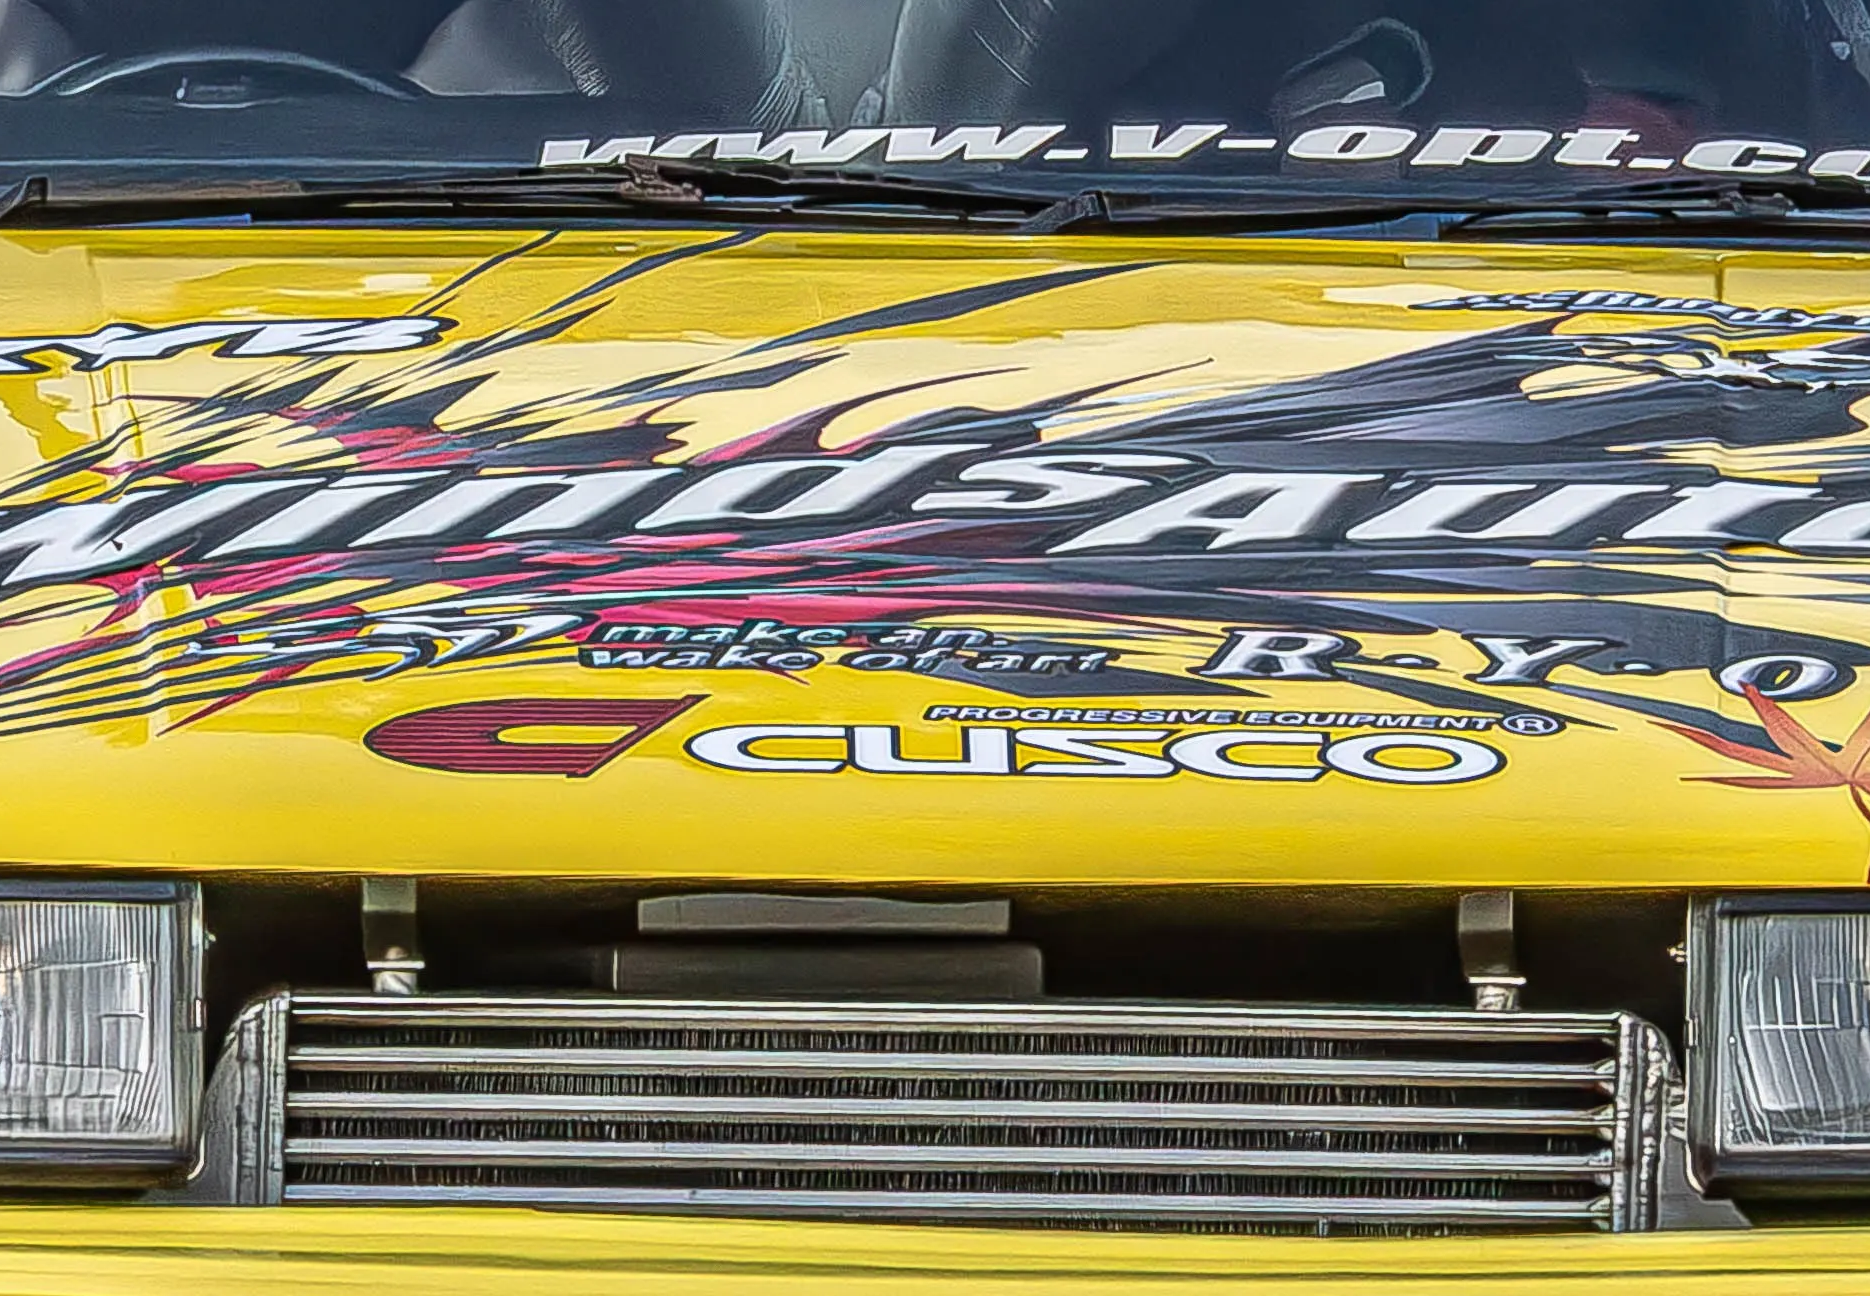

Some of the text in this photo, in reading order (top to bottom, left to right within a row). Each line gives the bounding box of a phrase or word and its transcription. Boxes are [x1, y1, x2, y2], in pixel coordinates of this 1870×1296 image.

[600, 620, 848, 646] make
[589, 644, 822, 670] wake
[849, 647, 954, 673] of
[928, 704, 1234, 726] PROGRESSIVE
[684, 723, 1507, 785] CUSCO
